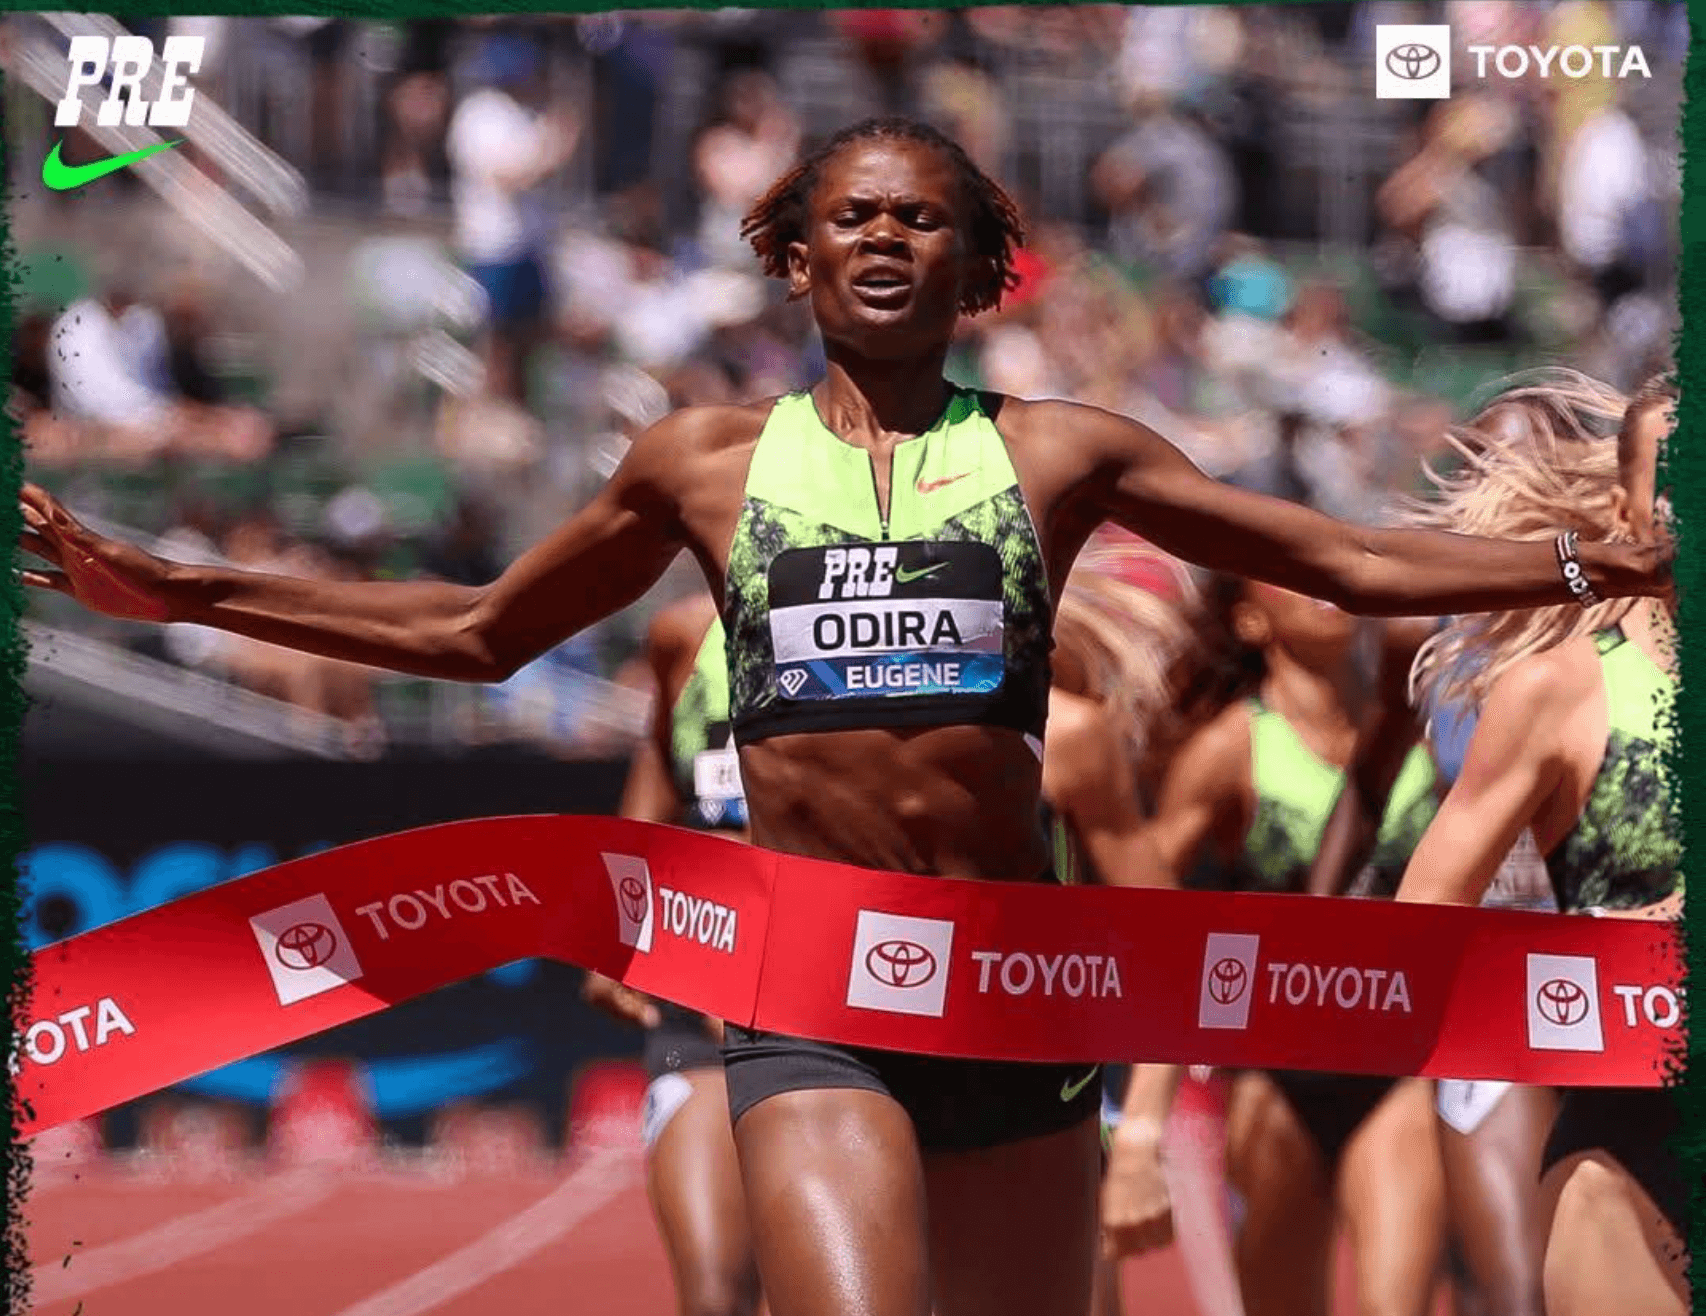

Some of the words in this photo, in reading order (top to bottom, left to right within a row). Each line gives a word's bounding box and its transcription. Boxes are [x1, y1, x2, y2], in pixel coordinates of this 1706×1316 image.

[819, 547, 897, 598] PRE
[813, 611, 963, 650] ODIRA
[846, 662, 962, 690] EUGENE
[354, 872, 541, 941] TOYOTA
[658, 886, 738, 954] TOYOTA
[971, 950, 1123, 999] TOYOTA
[1266, 962, 1412, 1013] TOYOTA
[1612, 985, 1687, 1028] TO
[8, 997, 136, 1076] OTA
